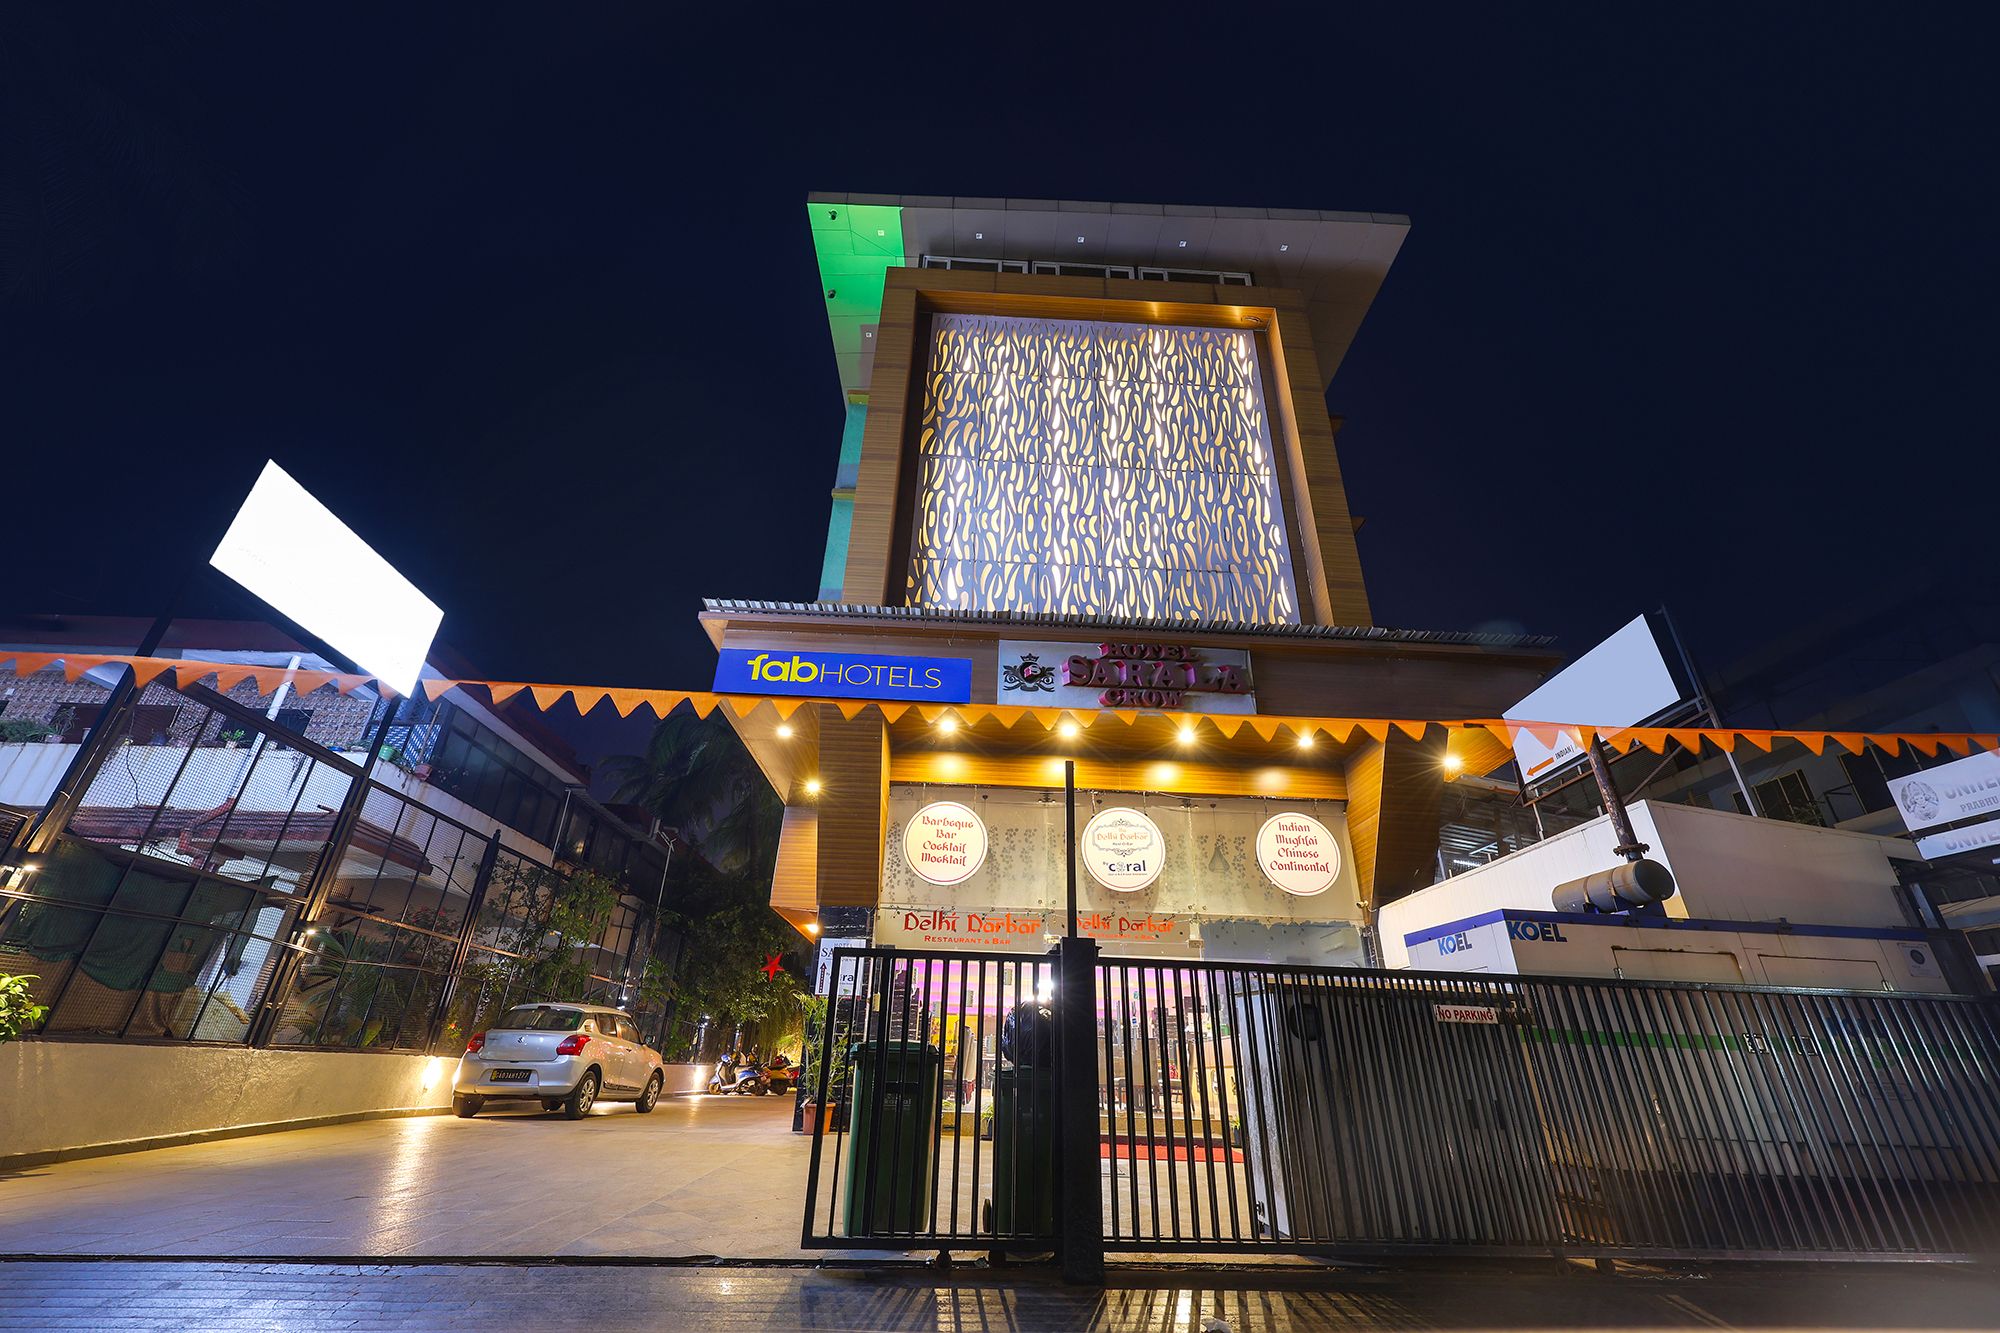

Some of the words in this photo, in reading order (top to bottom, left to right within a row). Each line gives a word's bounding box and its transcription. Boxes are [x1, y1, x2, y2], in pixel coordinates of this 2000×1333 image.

[1098, 642, 1200, 661] HOTEL
[747, 653, 942, 689] fabHOTELS
[1959, 795, 1999, 813] PRABHU
[922, 815, 974, 830] Barbeque
[1278, 822, 1311, 833] Indian
[936, 828, 957, 839] Bar
[1275, 834, 1319, 848] Mughlai
[922, 840, 967, 854] Cocktail
[1277, 847, 1320, 859] Chinese
[921, 852, 967, 867] Mocktail
[1269, 860, 1331, 874] Continental
[903, 909, 960, 932] Delhi
[967, 911, 1041, 935] Darbar
[1118, 913, 1176, 934] Darbar
[1506, 920, 1568, 943] KOEL
[924, 935, 982, 945] RESTAURANT
[1436, 931, 1473, 956] KOEL
[1438, 1007, 1452, 1020] NO
[1454, 1008, 1494, 1021] PARKING
